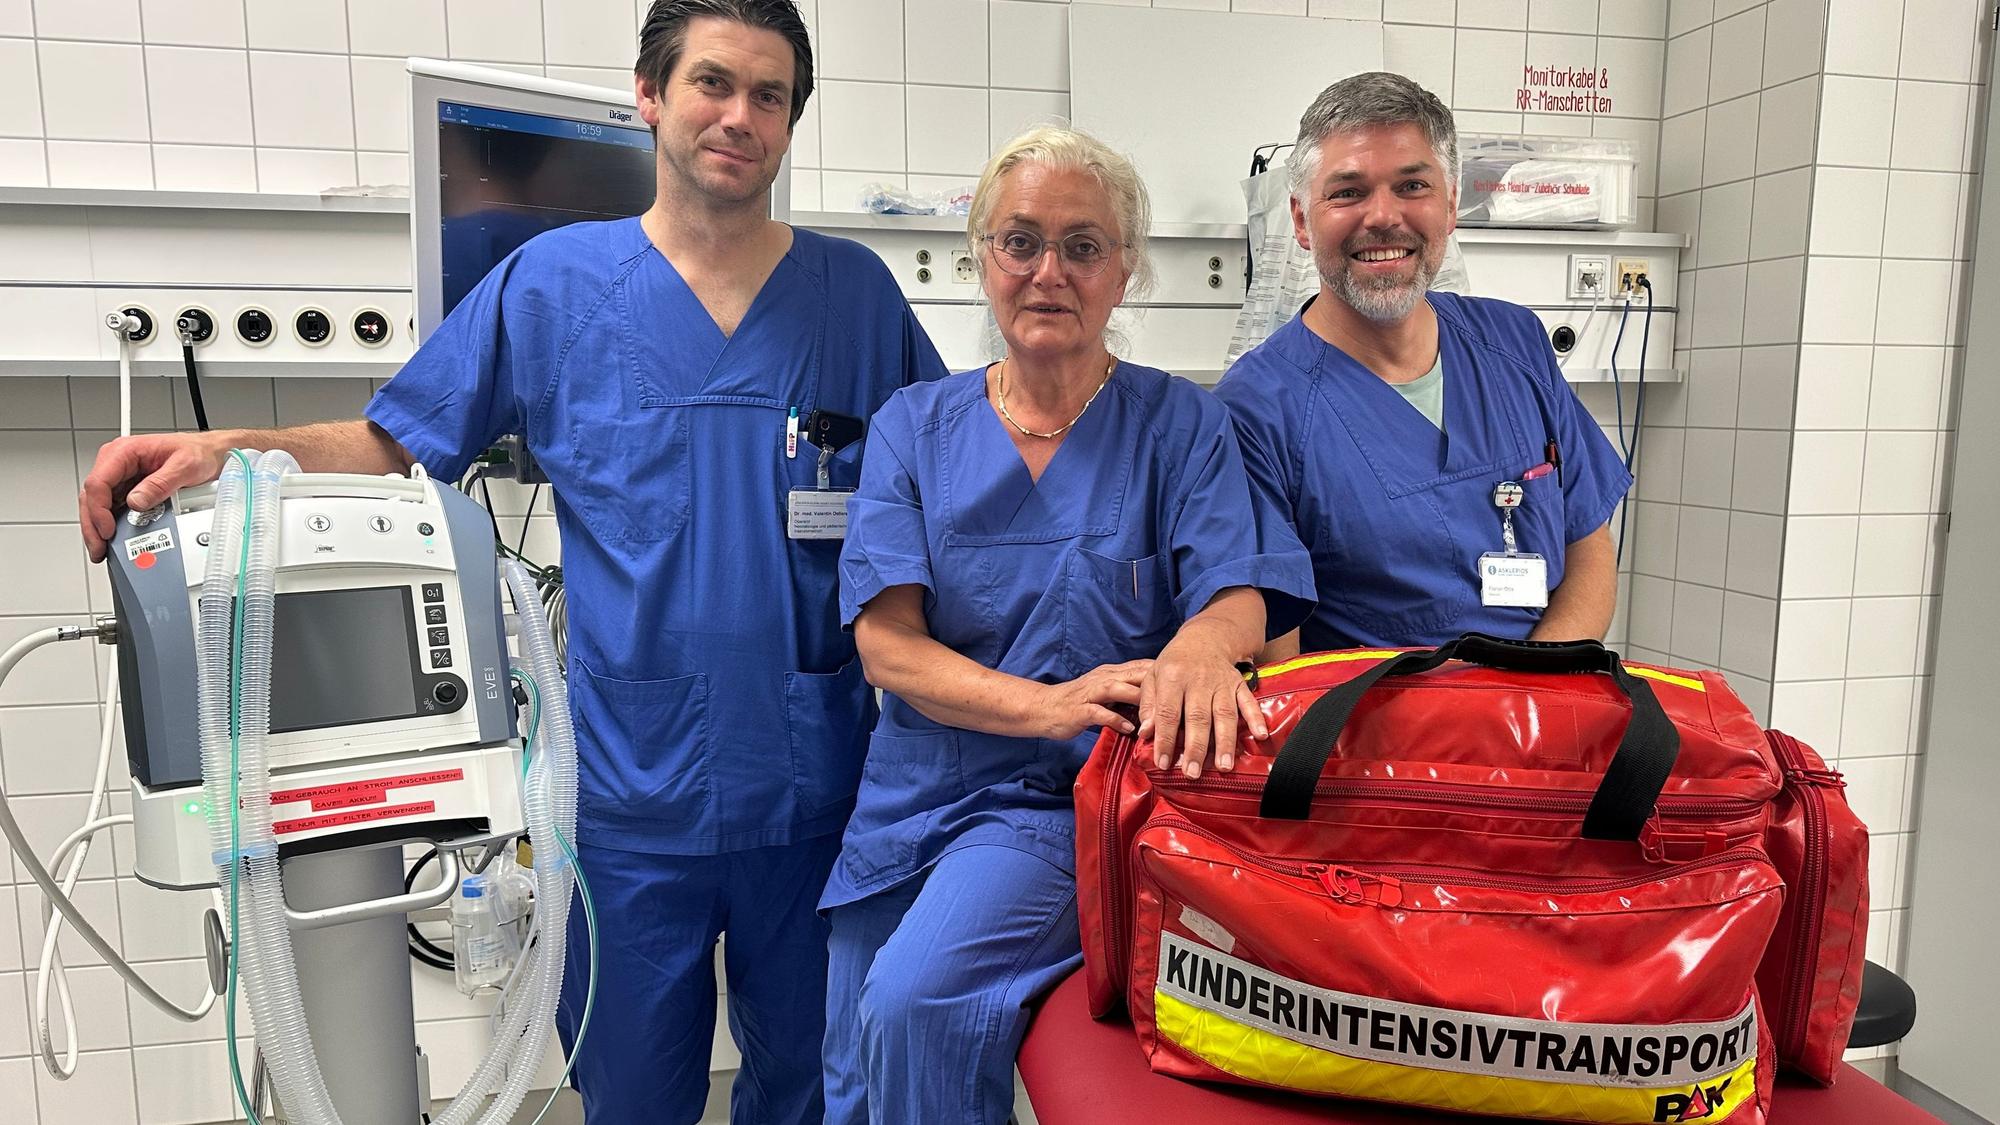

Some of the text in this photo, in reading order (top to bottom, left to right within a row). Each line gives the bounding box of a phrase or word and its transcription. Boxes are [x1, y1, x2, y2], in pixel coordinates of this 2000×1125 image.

[1524, 64, 1608, 89] Monitorkabel &
[1516, 89, 1612, 113] RR-Manschetten
[609, 109, 632, 123] Dräger
[576, 124, 602, 136] 16:59
[295, 788, 341, 799] GEBRAUCH
[364, 781, 393, 790] STROM
[275, 824, 293, 832] TTE
[298, 821, 316, 829] NUR
[322, 817, 337, 825] MIT
[343, 813, 372, 822] FILTER
[1165, 944, 1754, 1078] KINDERINTENSIVTRANSPORT
